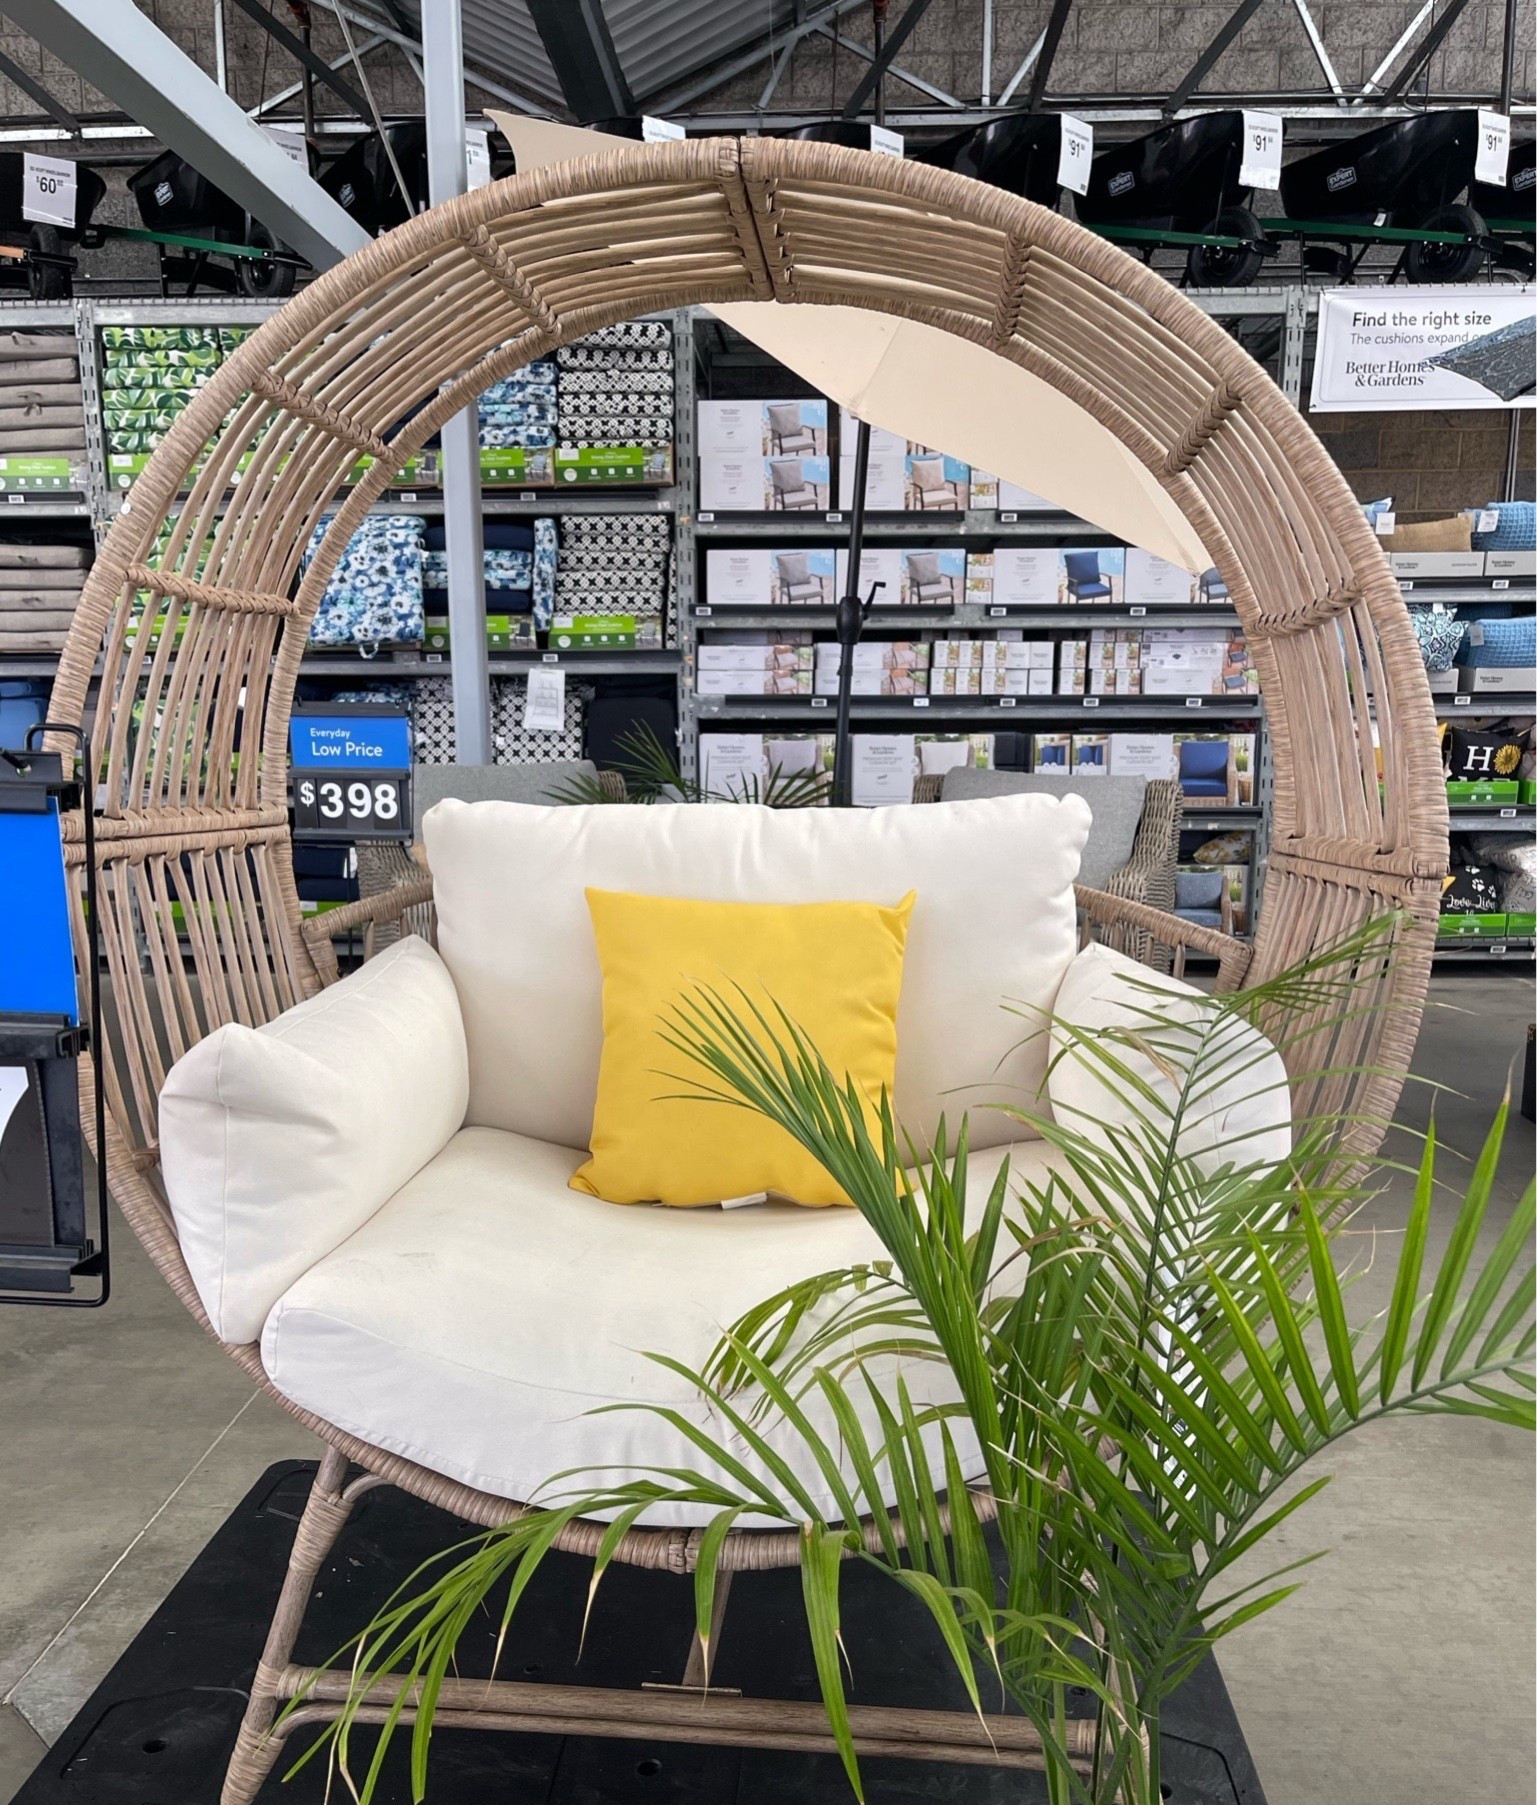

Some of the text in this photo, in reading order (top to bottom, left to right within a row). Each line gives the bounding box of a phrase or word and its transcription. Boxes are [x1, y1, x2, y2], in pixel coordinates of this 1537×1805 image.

[1352, 311, 1492, 330] Find the right size
[1350, 333, 1372, 345] The
[1374, 333, 1424, 344] cushions
[1428, 332, 1469, 347] expand
[1346, 361, 1387, 375] Better
[1367, 373, 1425, 387] Gardens
[310, 728, 351, 739] Everyday
[311, 742, 383, 756] Low Price
